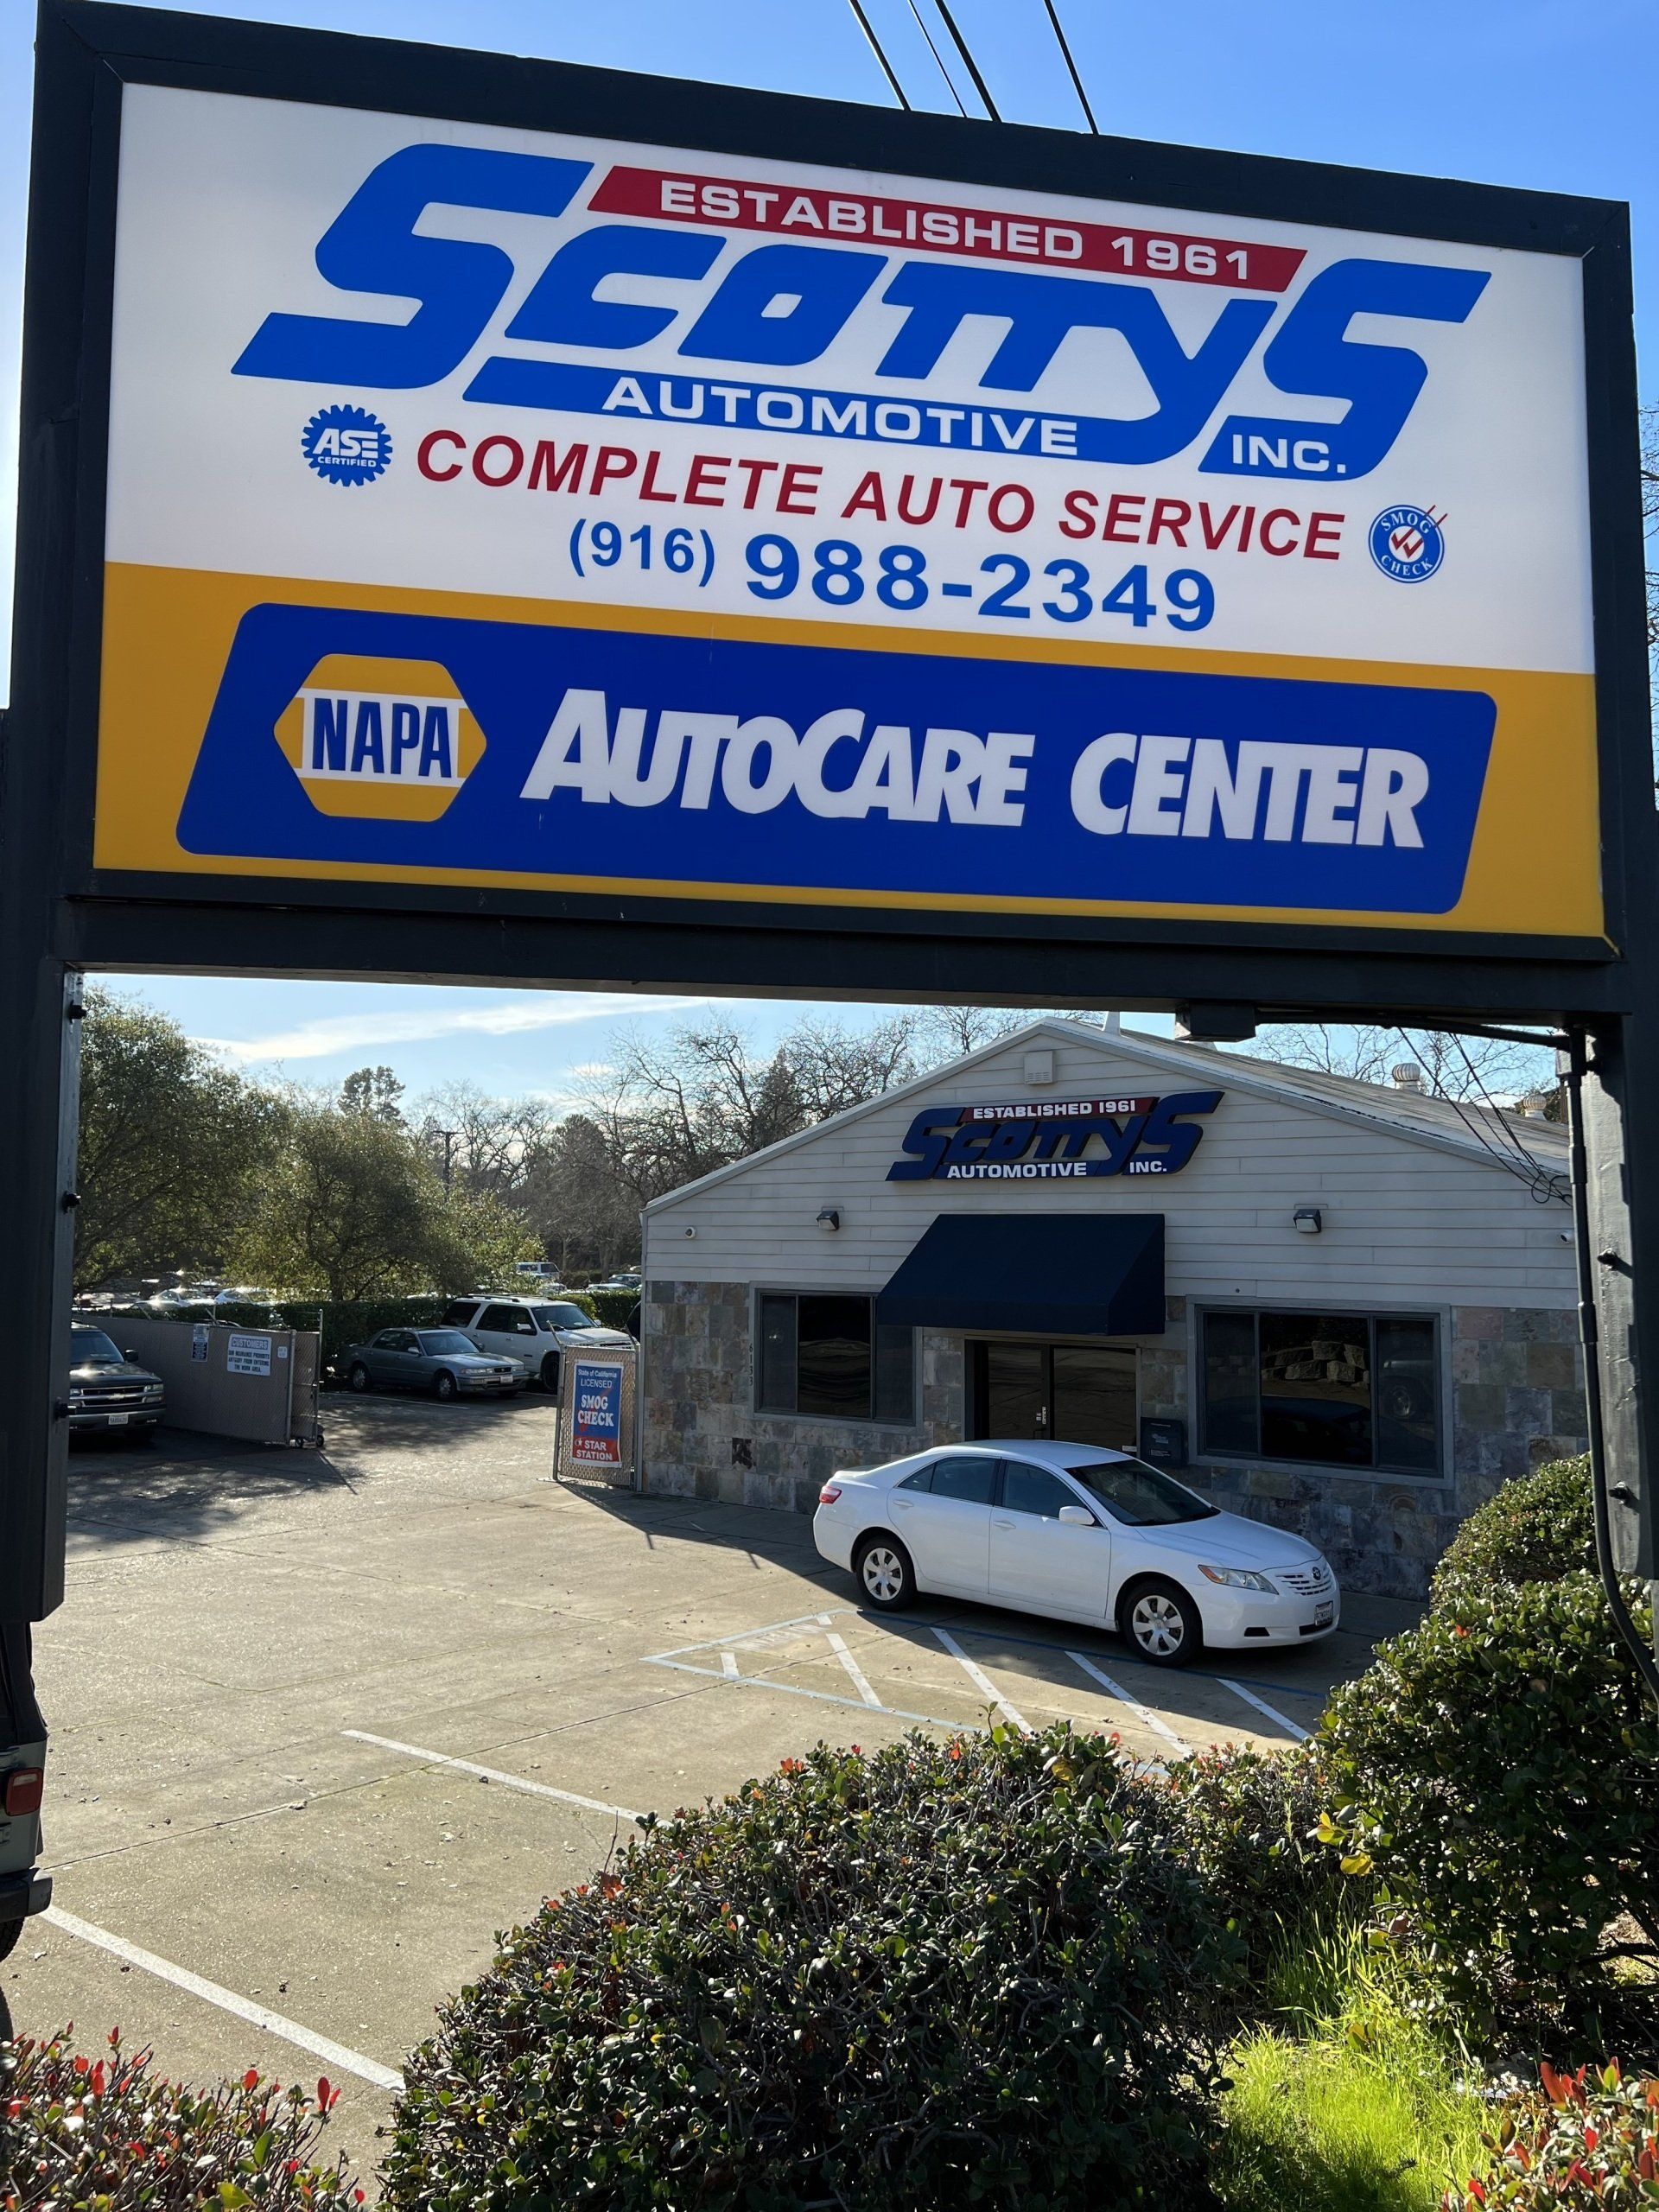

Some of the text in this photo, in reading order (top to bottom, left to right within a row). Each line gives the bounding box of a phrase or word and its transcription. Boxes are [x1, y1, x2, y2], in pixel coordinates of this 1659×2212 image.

[660, 179, 1250, 281] ESTABLISHED 1961
[602, 378, 1347, 474] AUTOMOTIVE INC.
[312, 428, 378, 459] ASE
[317, 456, 377, 467] CERTIFIED
[417, 429, 1345, 561] COMPLETE AUTO SERVICE
[1381, 512, 1432, 534] SMOG
[569, 518, 1216, 632] (916) 988-2349
[1381, 555, 1433, 575] CHECK
[312, 698, 453, 779] NAPA
[519, 688, 1429, 849] AUTOCARE CENTER
[973, 1100, 1135, 1120] ESTABLISHED 1961
[947, 1160, 1167, 1179] AUTOMOTIVE INC.
[232, 1338, 268, 1350] CUSTOMERS
[581, 1379, 612, 1389] LICENSED
[594, 1370, 617, 1378] California
[581, 1394, 608, 1410] SMOG
[577, 1410, 614, 1427] CHECK
[576, 1449, 613, 1461] STATION
[584, 1440, 607, 1452] STAR
